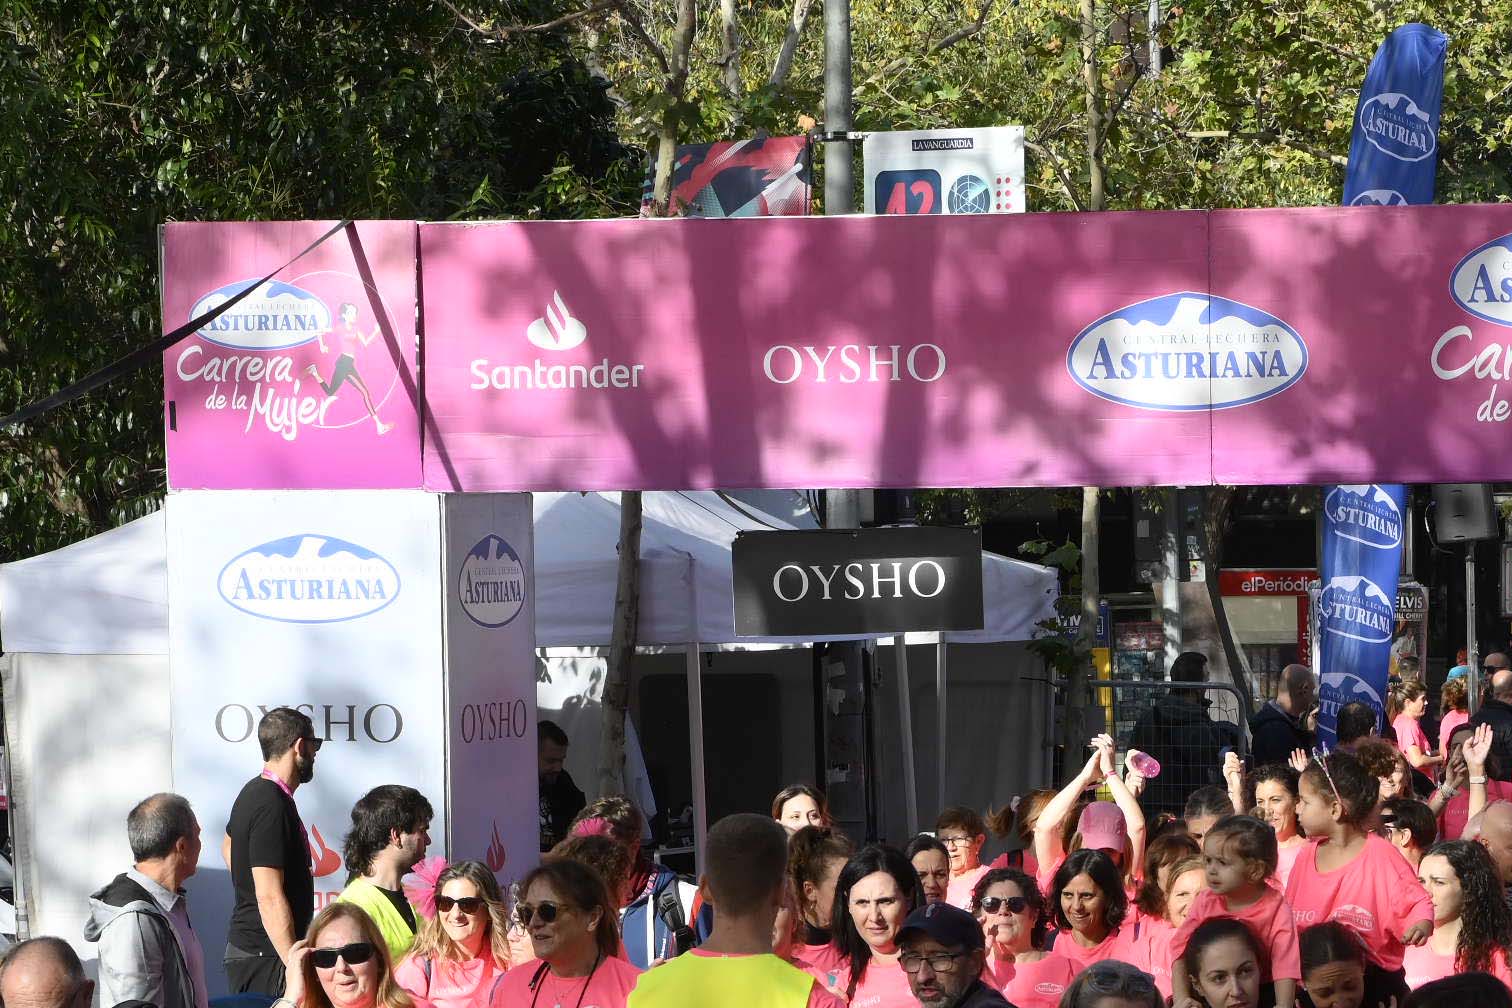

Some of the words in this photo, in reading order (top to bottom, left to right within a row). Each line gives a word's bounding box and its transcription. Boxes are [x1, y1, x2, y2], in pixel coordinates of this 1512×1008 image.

[924, 138, 973, 150] VANGUARDIA
[200, 305, 319, 332] ASTURIANA
[176, 345, 294, 382] Carrera
[470, 358, 645, 390] Santander
[763, 343, 947, 384] OYSHO
[1086, 338, 1289, 380] ASTURIANA
[205, 384, 226, 409] de
[231, 384, 248, 409] la
[245, 379, 339, 441] Mujer
[1476, 384, 1511, 422] de
[1336, 505, 1399, 540] STURIANA
[232, 567, 387, 600] ASTURIANA
[464, 567, 522, 605] ASTURIANA
[773, 561, 946, 602] OYSHO
[214, 703, 403, 743] OHO
[461, 699, 528, 744] OYSHO
